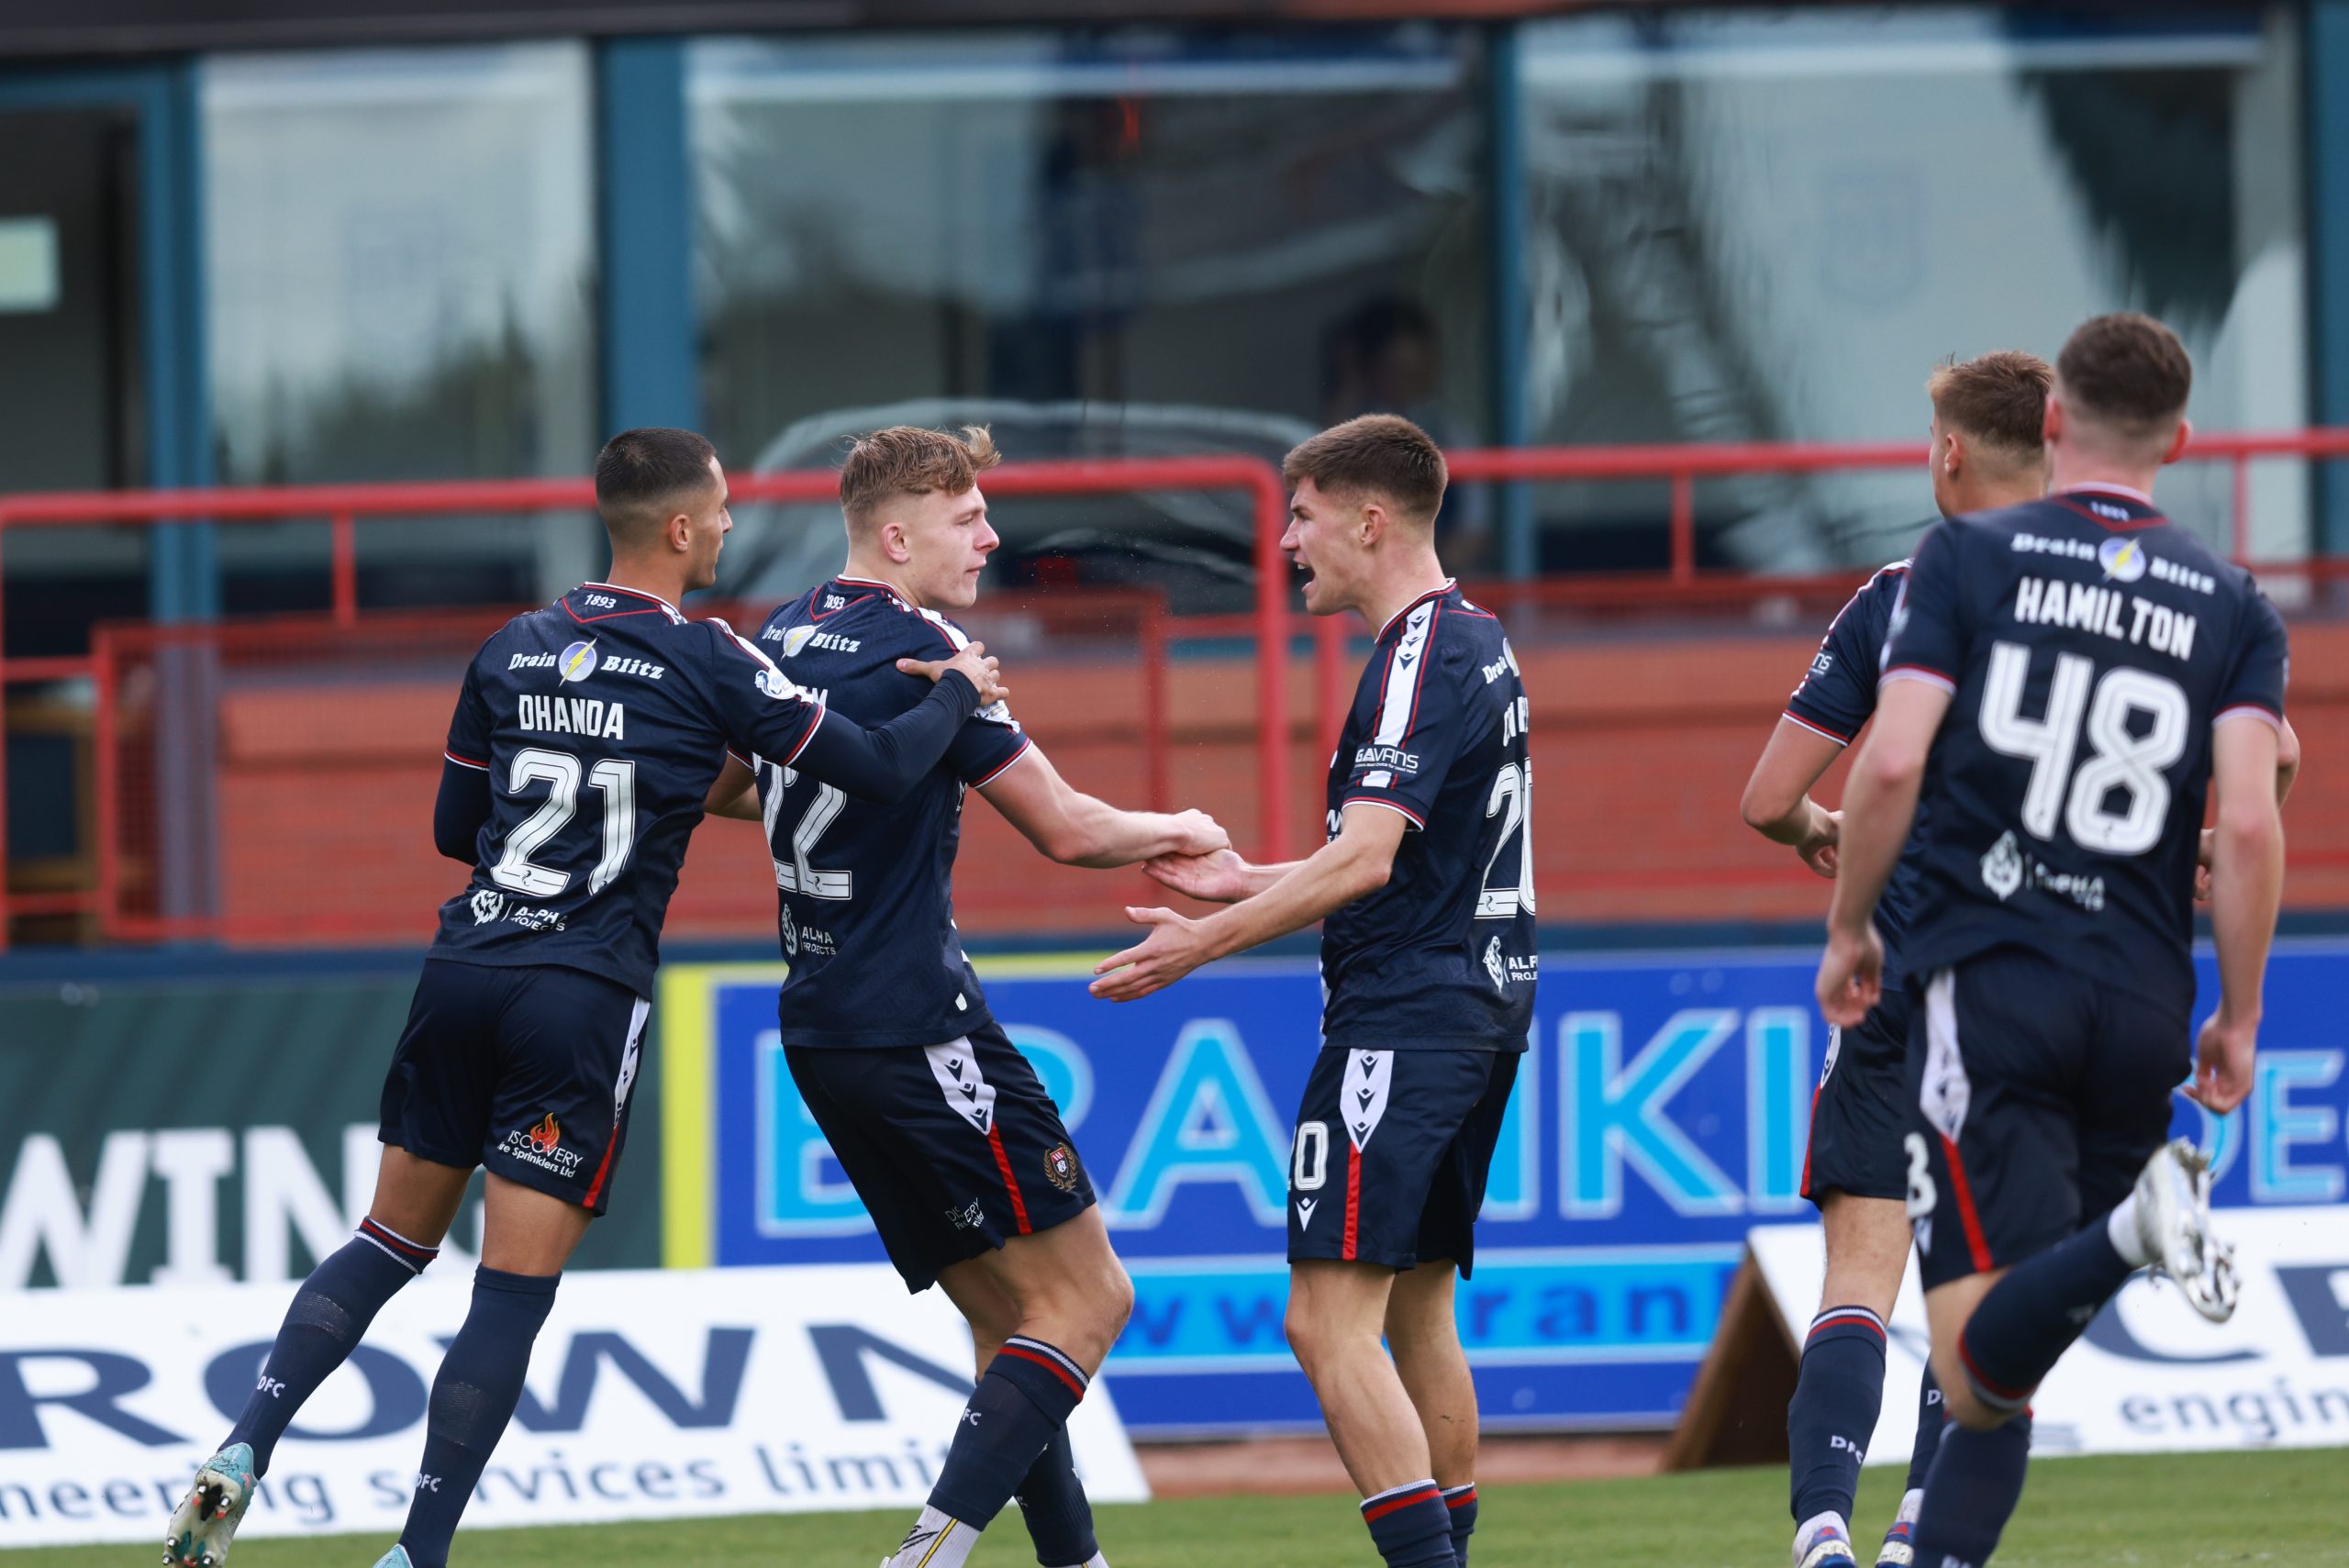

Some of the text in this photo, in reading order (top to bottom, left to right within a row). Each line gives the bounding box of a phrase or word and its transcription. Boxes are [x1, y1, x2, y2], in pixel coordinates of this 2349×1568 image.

[584, 594, 617, 609] 1893
[823, 594, 846, 610] 1893
[2014, 576, 2197, 662] HAMILTON
[808, 632, 862, 652] Blitz
[508, 651, 665, 680] Drain Blitz
[518, 694, 624, 741] DHANDA
[1979, 641, 2190, 855] 48
[491, 747, 635, 897] 21
[511, 1146, 560, 1173] Sprinklers
[559, 1165, 577, 1179] Ltd
[1286, 1120, 1329, 1191] 0
[256, 1375, 286, 1399] DFC
[369, 1450, 727, 1509] srvices
